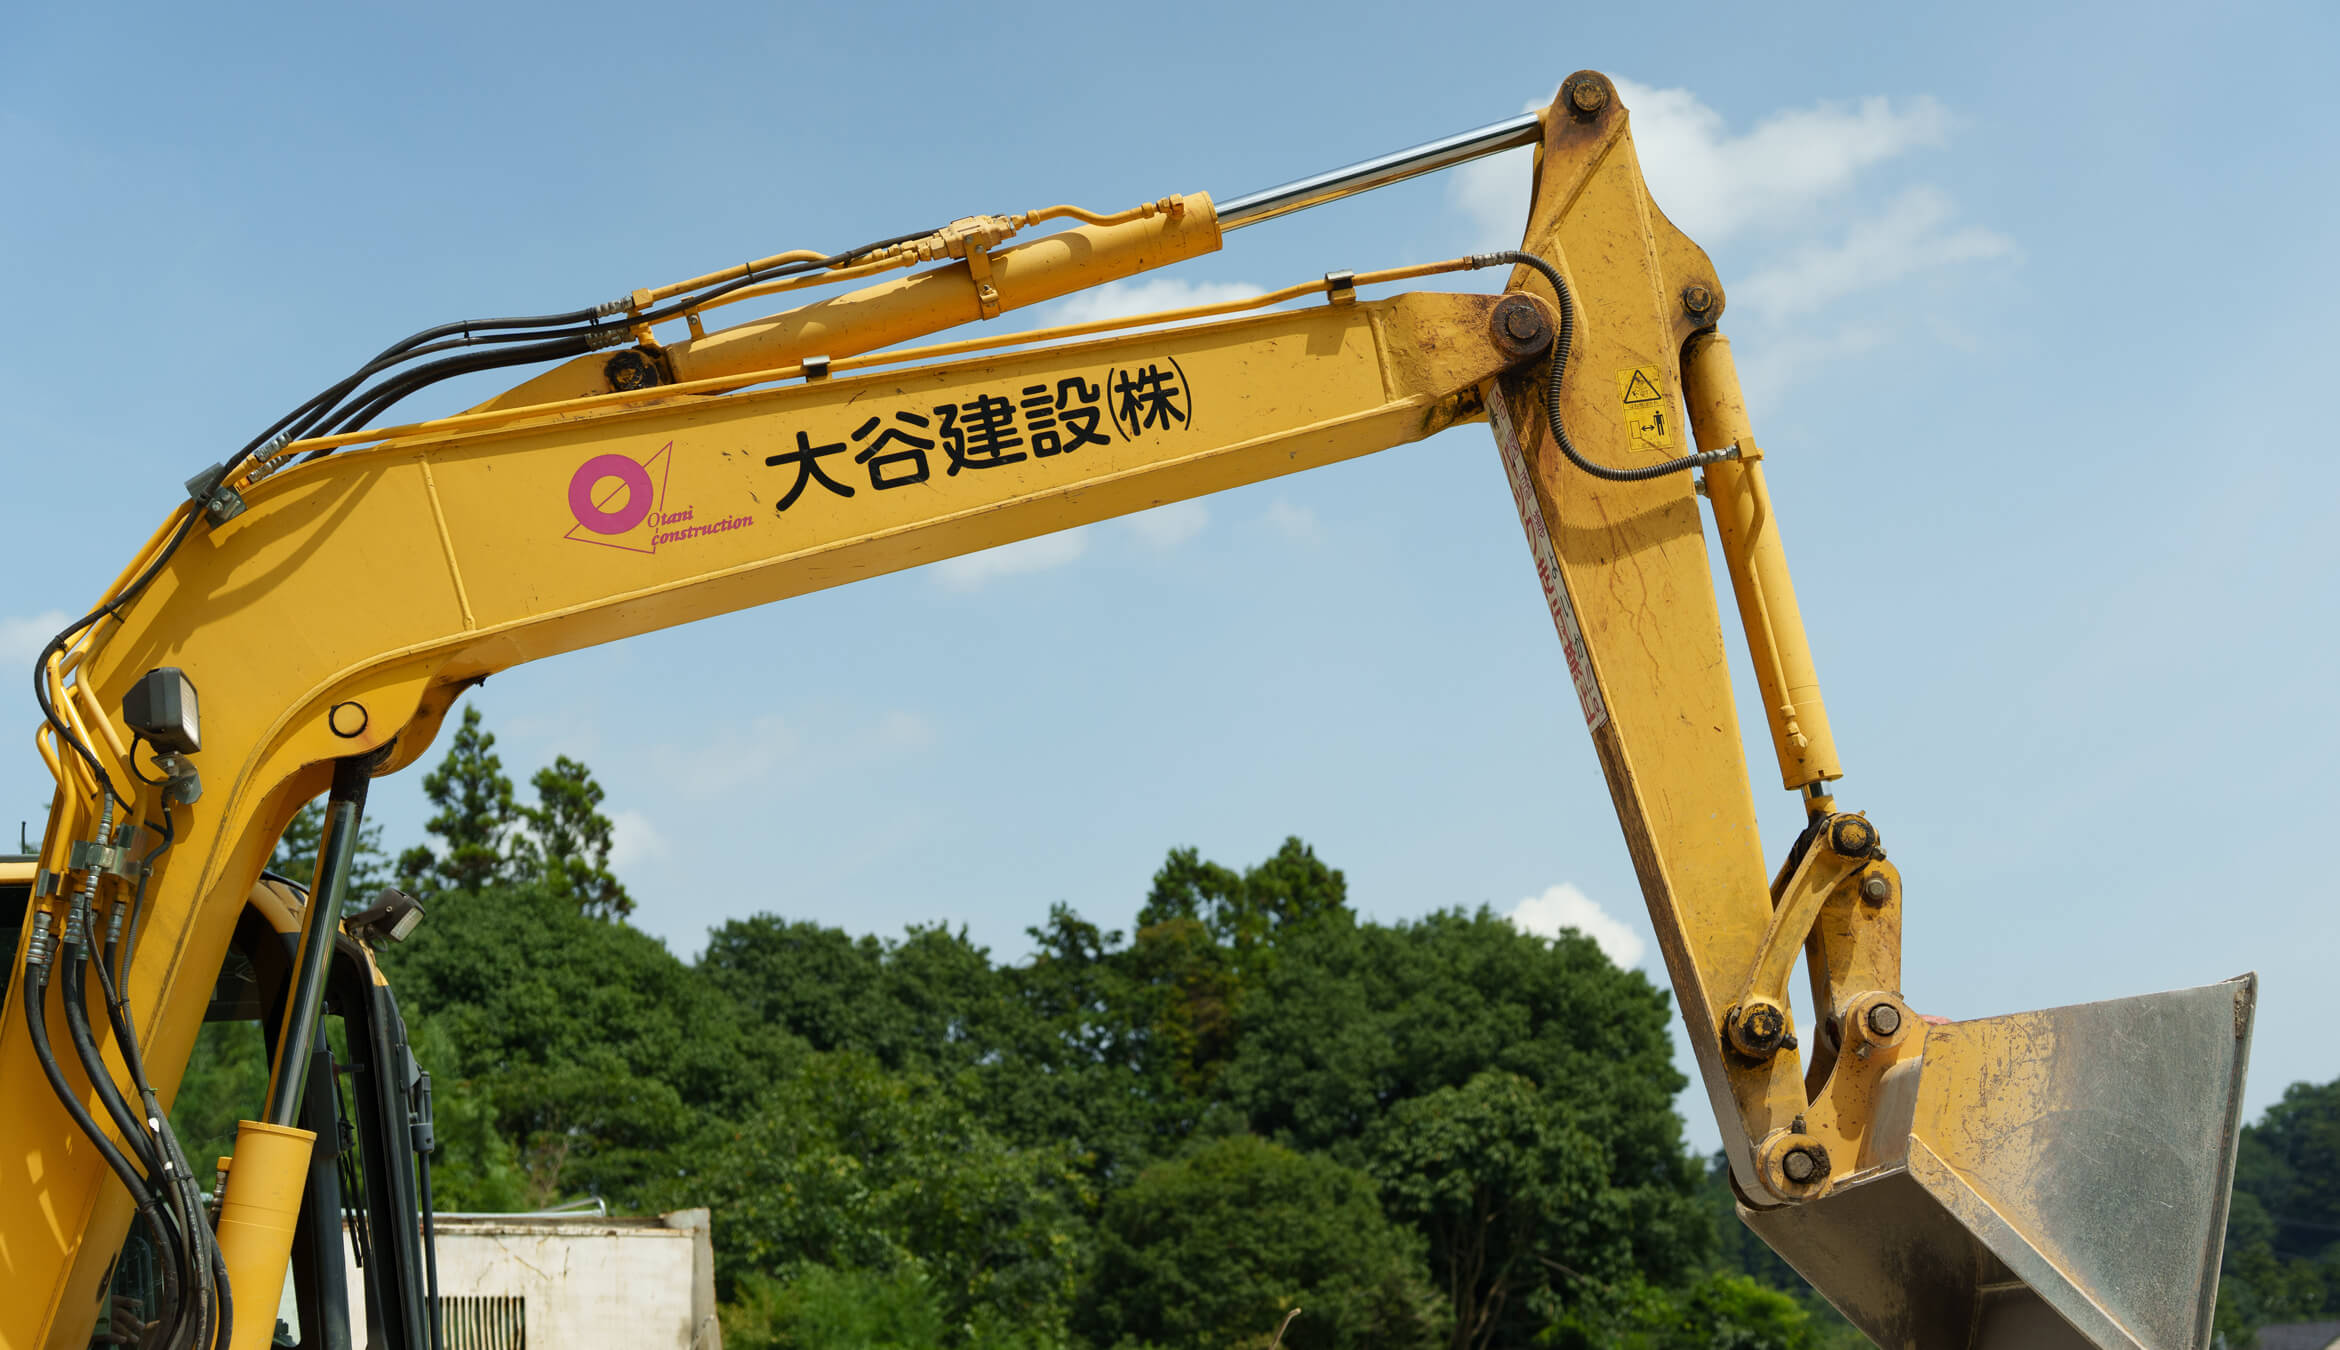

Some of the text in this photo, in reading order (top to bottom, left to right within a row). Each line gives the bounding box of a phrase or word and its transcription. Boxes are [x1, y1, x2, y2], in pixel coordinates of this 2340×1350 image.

[765, 356, 1192, 512] 大谷建設(株)
[647, 504, 694, 528] Otani
[651, 515, 754, 546] construction
[1501, 441, 1596, 726] バック走行禁止
